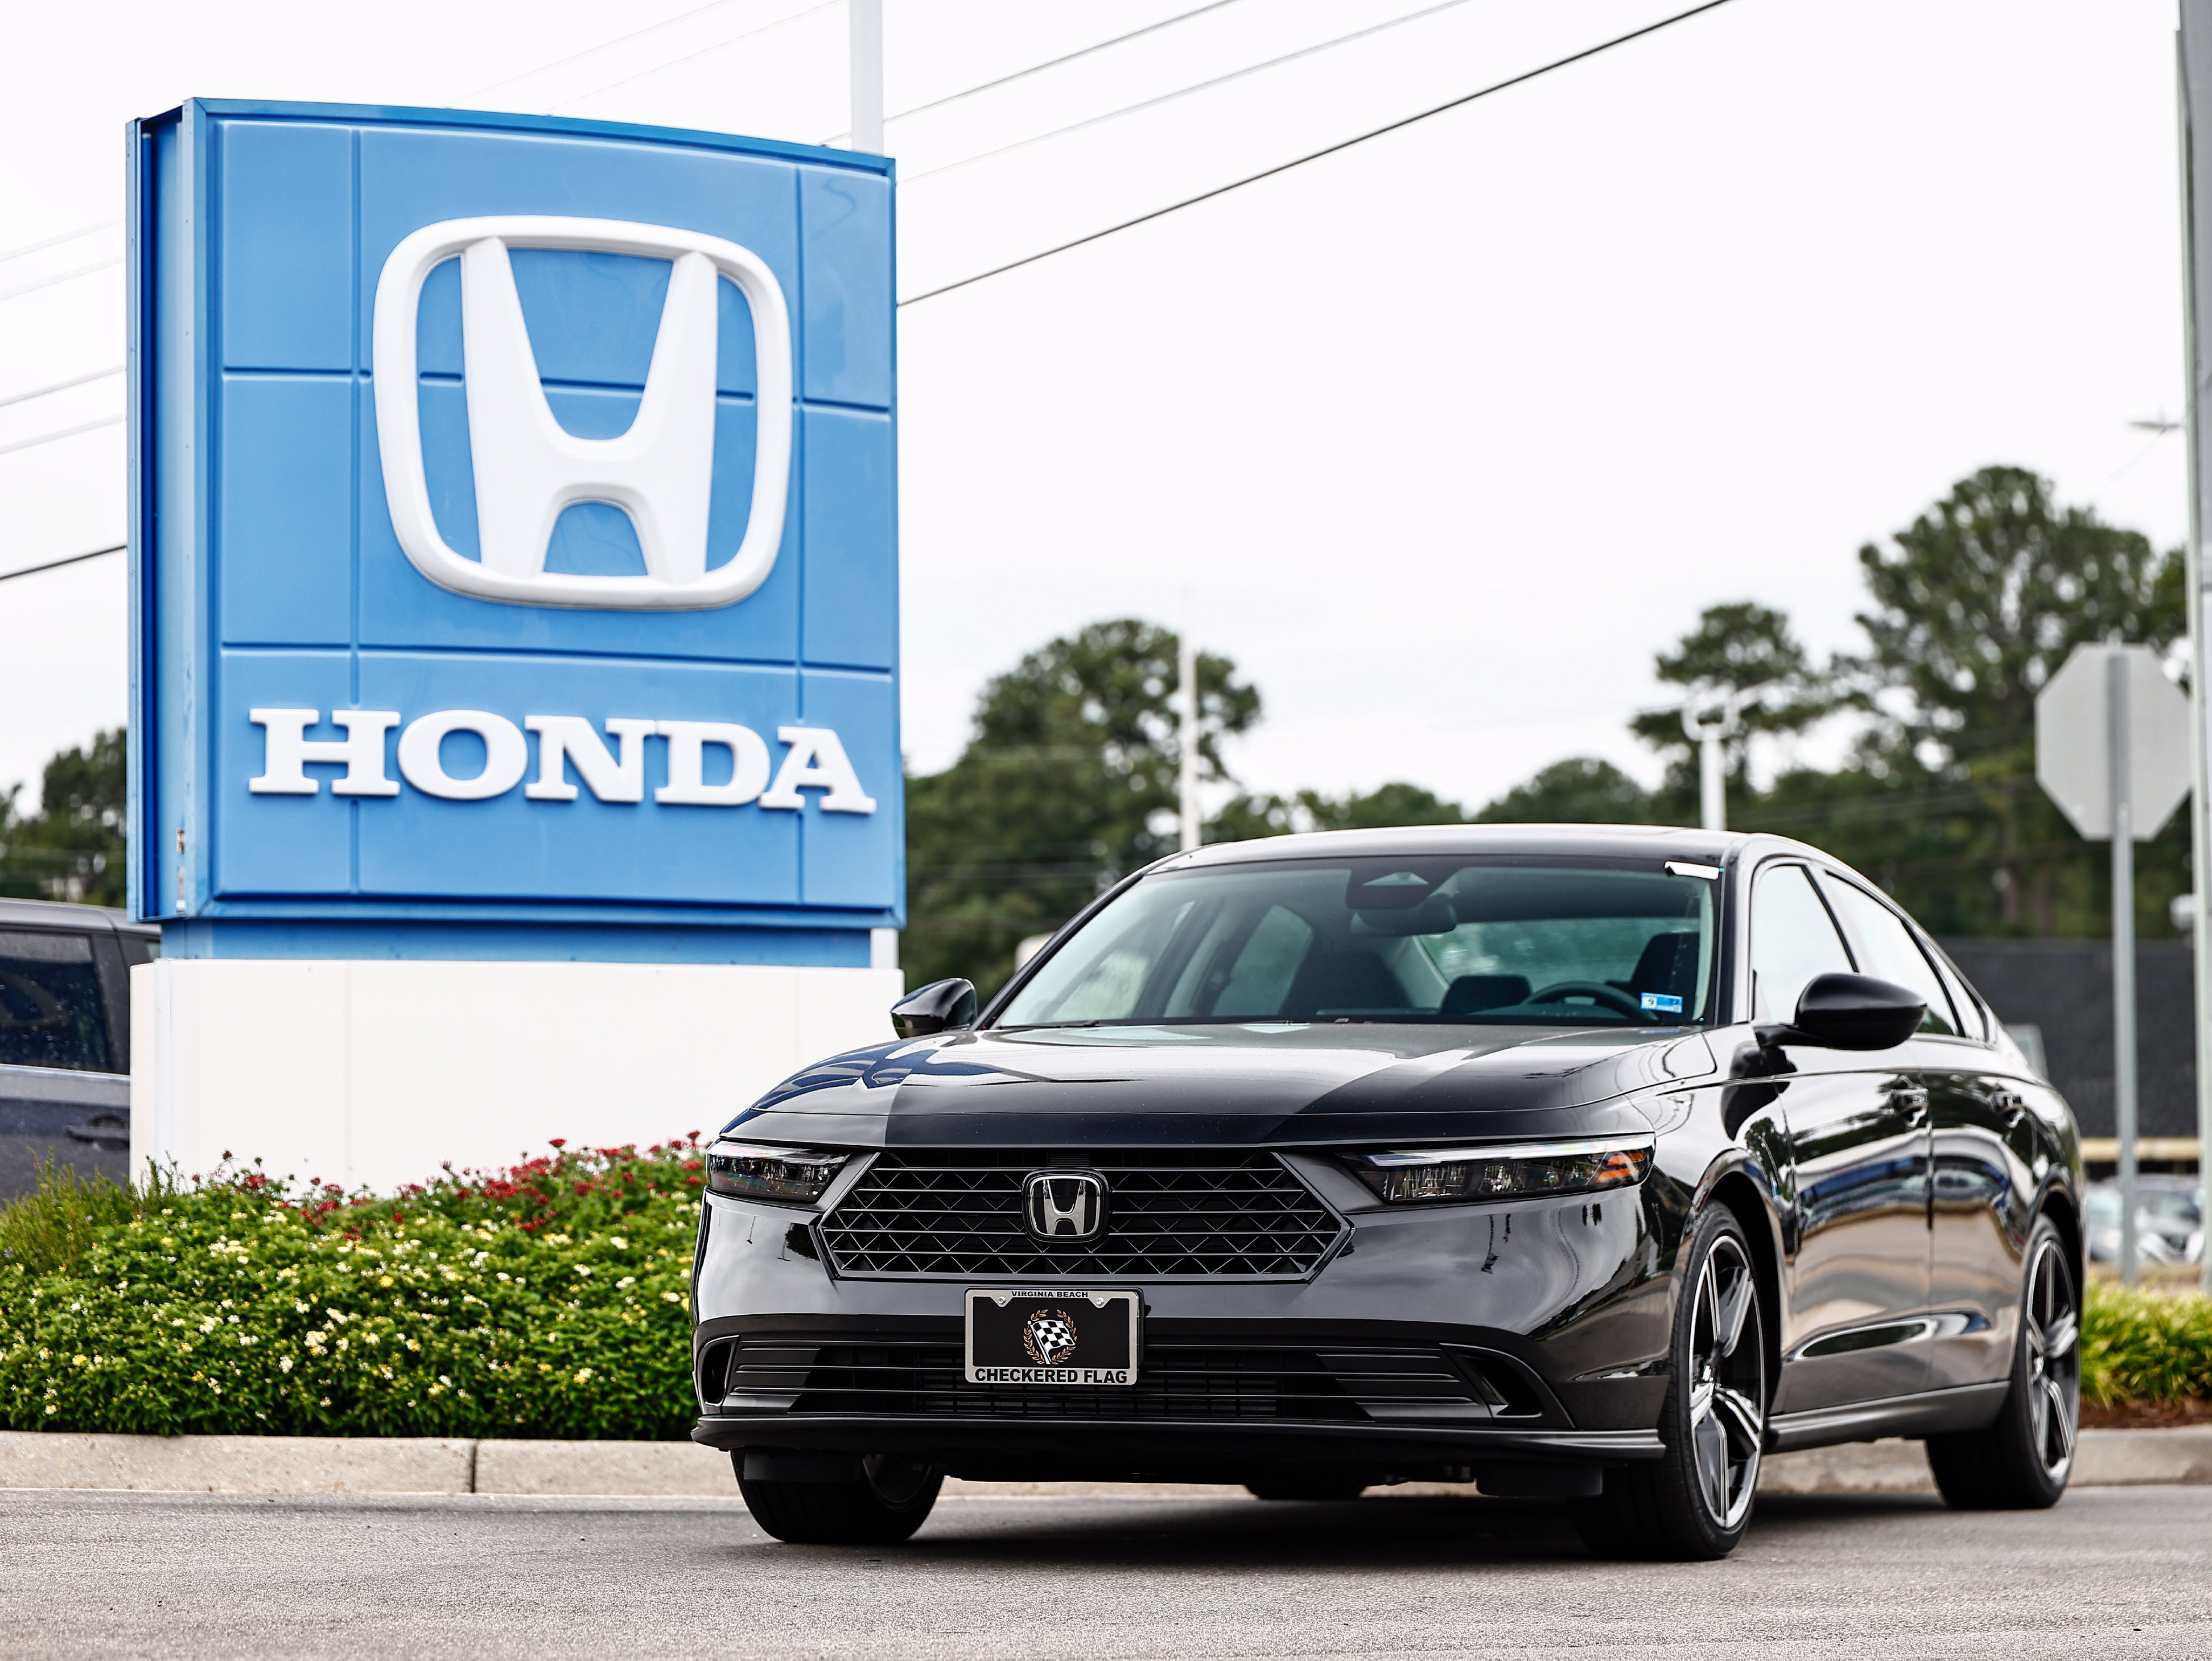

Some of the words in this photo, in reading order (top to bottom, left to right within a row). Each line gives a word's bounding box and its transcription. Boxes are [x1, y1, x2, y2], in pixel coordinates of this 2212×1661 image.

[249, 708, 876, 813] HONDA
[975, 1368, 1078, 1382] CHECKERED
[1084, 1370, 1127, 1383] FLAG
